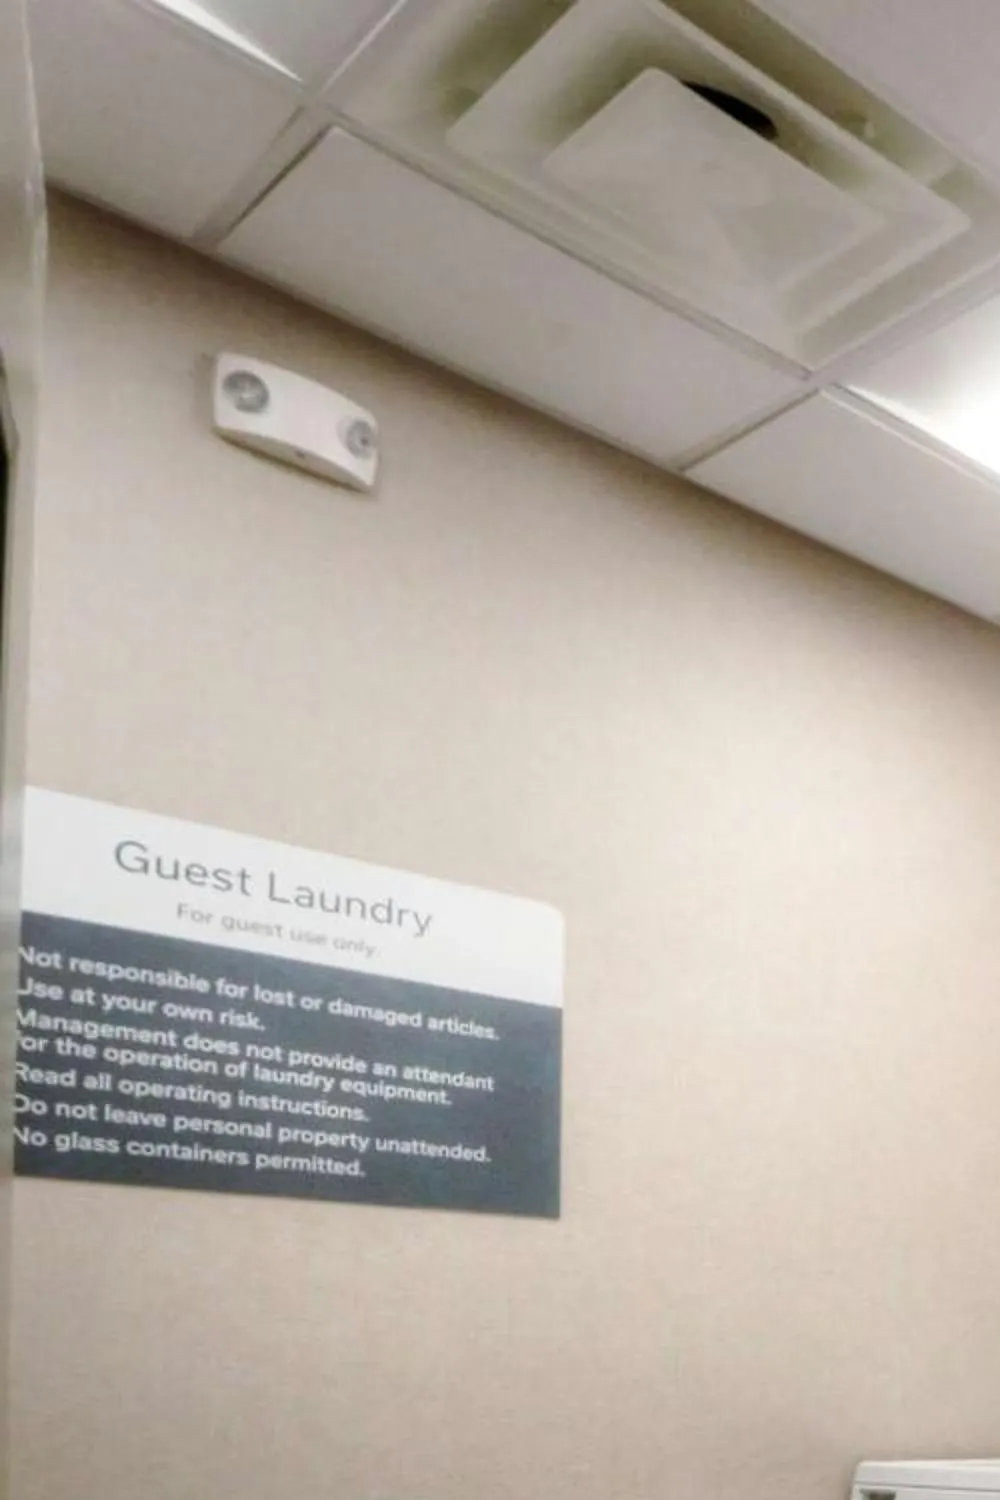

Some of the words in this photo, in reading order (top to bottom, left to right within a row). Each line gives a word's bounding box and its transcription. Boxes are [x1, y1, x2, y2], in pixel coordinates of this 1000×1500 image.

[114, 840, 252, 897] Guest
[268, 871, 433, 937] Laundry
[176, 902, 214, 924] For
[221, 916, 283, 938] guest
[289, 930, 328, 947] use
[69, 957, 210, 992] responsible
[215, 977, 248, 999] for
[254, 984, 295, 1007] lost
[299, 996, 323, 1012] or
[328, 998, 423, 1028] damaged
[427, 1017, 501, 1041] articles.
[71, 987, 95, 1006] at
[102, 994, 157, 1015] your
[161, 1002, 214, 1024] own
[219, 1009, 266, 1032] risk.
[16, 1008, 177, 1048] Management
[183, 1032, 240, 1055] does
[246, 1043, 283, 1063] not
[288, 1047, 368, 1075] provide
[372, 1063, 397, 1078] an
[403, 1065, 495, 1092] attendant
[55, 1037, 97, 1059] the
[103, 1048, 218, 1075] operation
[224, 1061, 249, 1078] of
[254, 1063, 335, 1093] laundry
[340, 1079, 453, 1106] equipment.
[83, 1072, 112, 1092] all
[118, 1080, 232, 1109] operating
[238, 1090, 369, 1122] instructions.
[54, 1130, 120, 1153] glass
[126, 1140, 250, 1166] containers
[255, 1151, 365, 1177] permitted.
[55, 1100, 98, 1121] not
[104, 1104, 166, 1128] leave
[173, 1115, 272, 1140] personal
[278, 1127, 370, 1153] property
[375, 1136, 492, 1163] unattended.
